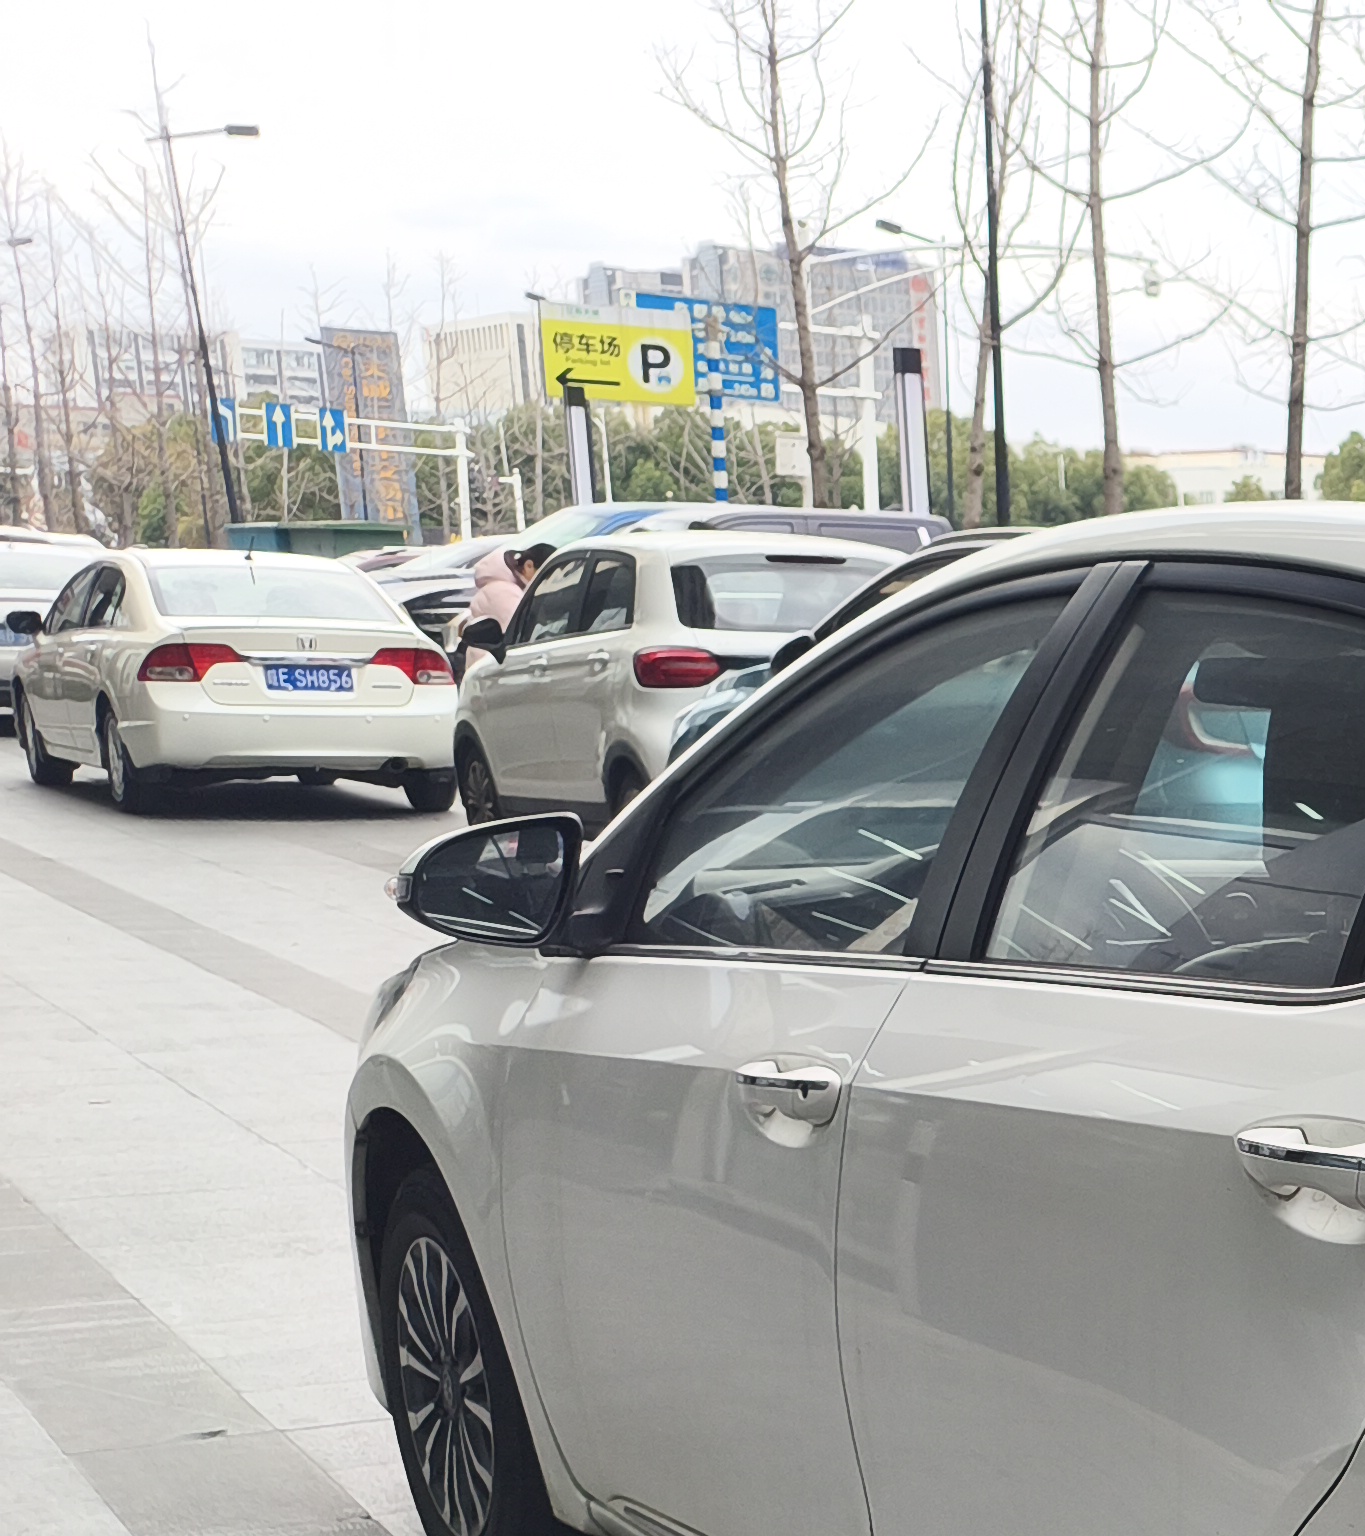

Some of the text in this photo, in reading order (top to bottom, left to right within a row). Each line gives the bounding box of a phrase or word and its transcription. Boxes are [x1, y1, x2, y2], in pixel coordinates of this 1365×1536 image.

[553, 331, 621, 358] 停车场
[640, 343, 671, 383] P
